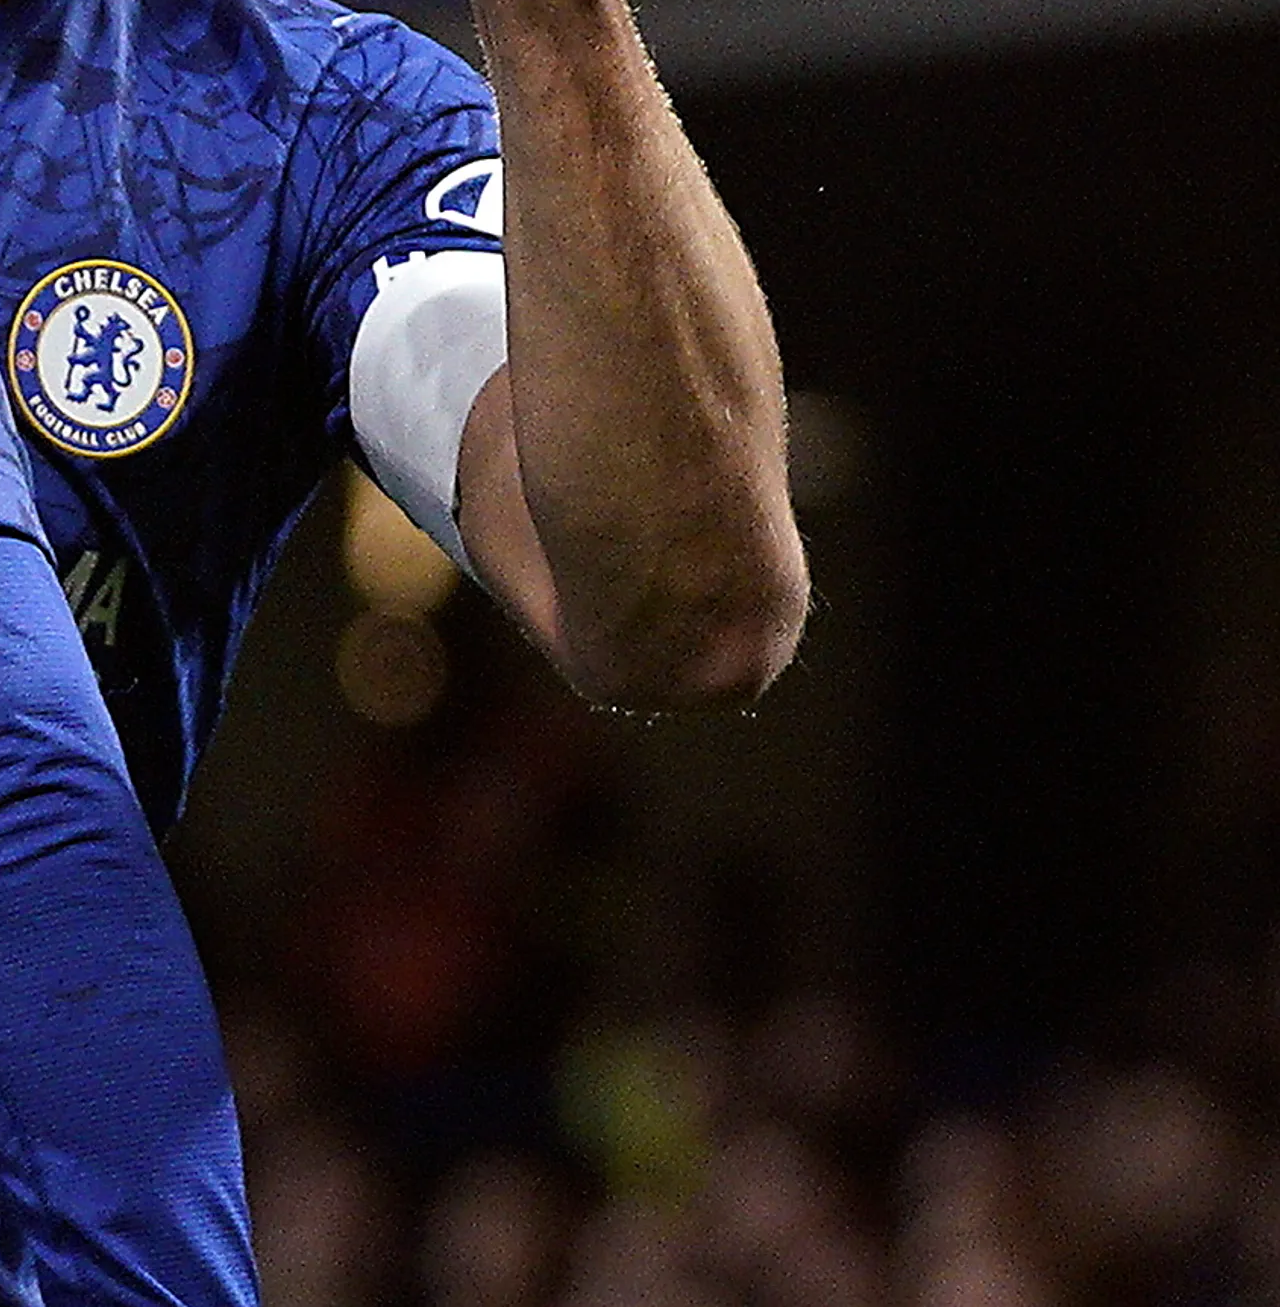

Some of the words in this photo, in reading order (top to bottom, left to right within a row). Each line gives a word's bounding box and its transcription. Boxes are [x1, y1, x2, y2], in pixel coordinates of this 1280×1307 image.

[53, 267, 171, 326] CHELSEA
[28, 394, 99, 447] FOOTBALL
[104, 421, 147, 447] CLUB
